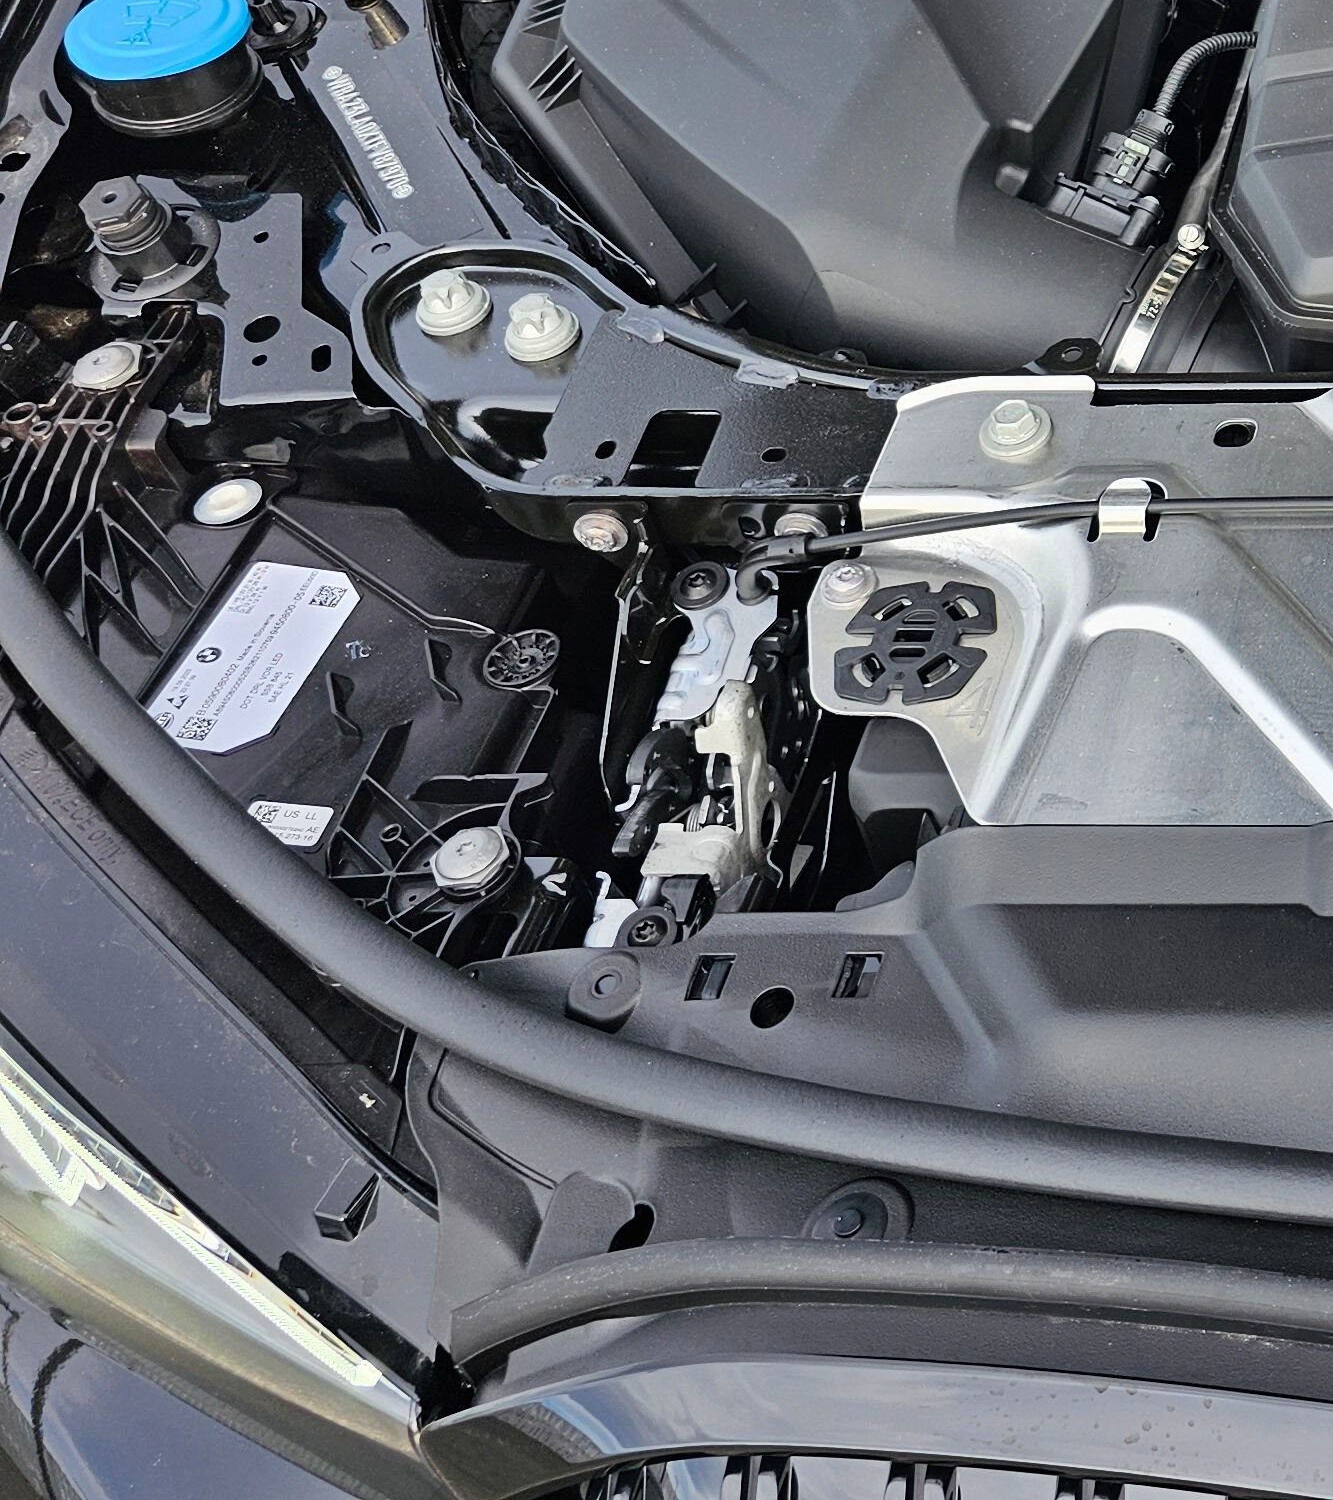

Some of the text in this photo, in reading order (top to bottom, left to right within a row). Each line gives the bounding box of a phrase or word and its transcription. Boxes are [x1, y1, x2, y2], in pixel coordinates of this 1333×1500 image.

[282, 808, 318, 820] US LL
[305, 825, 321, 834] AE
